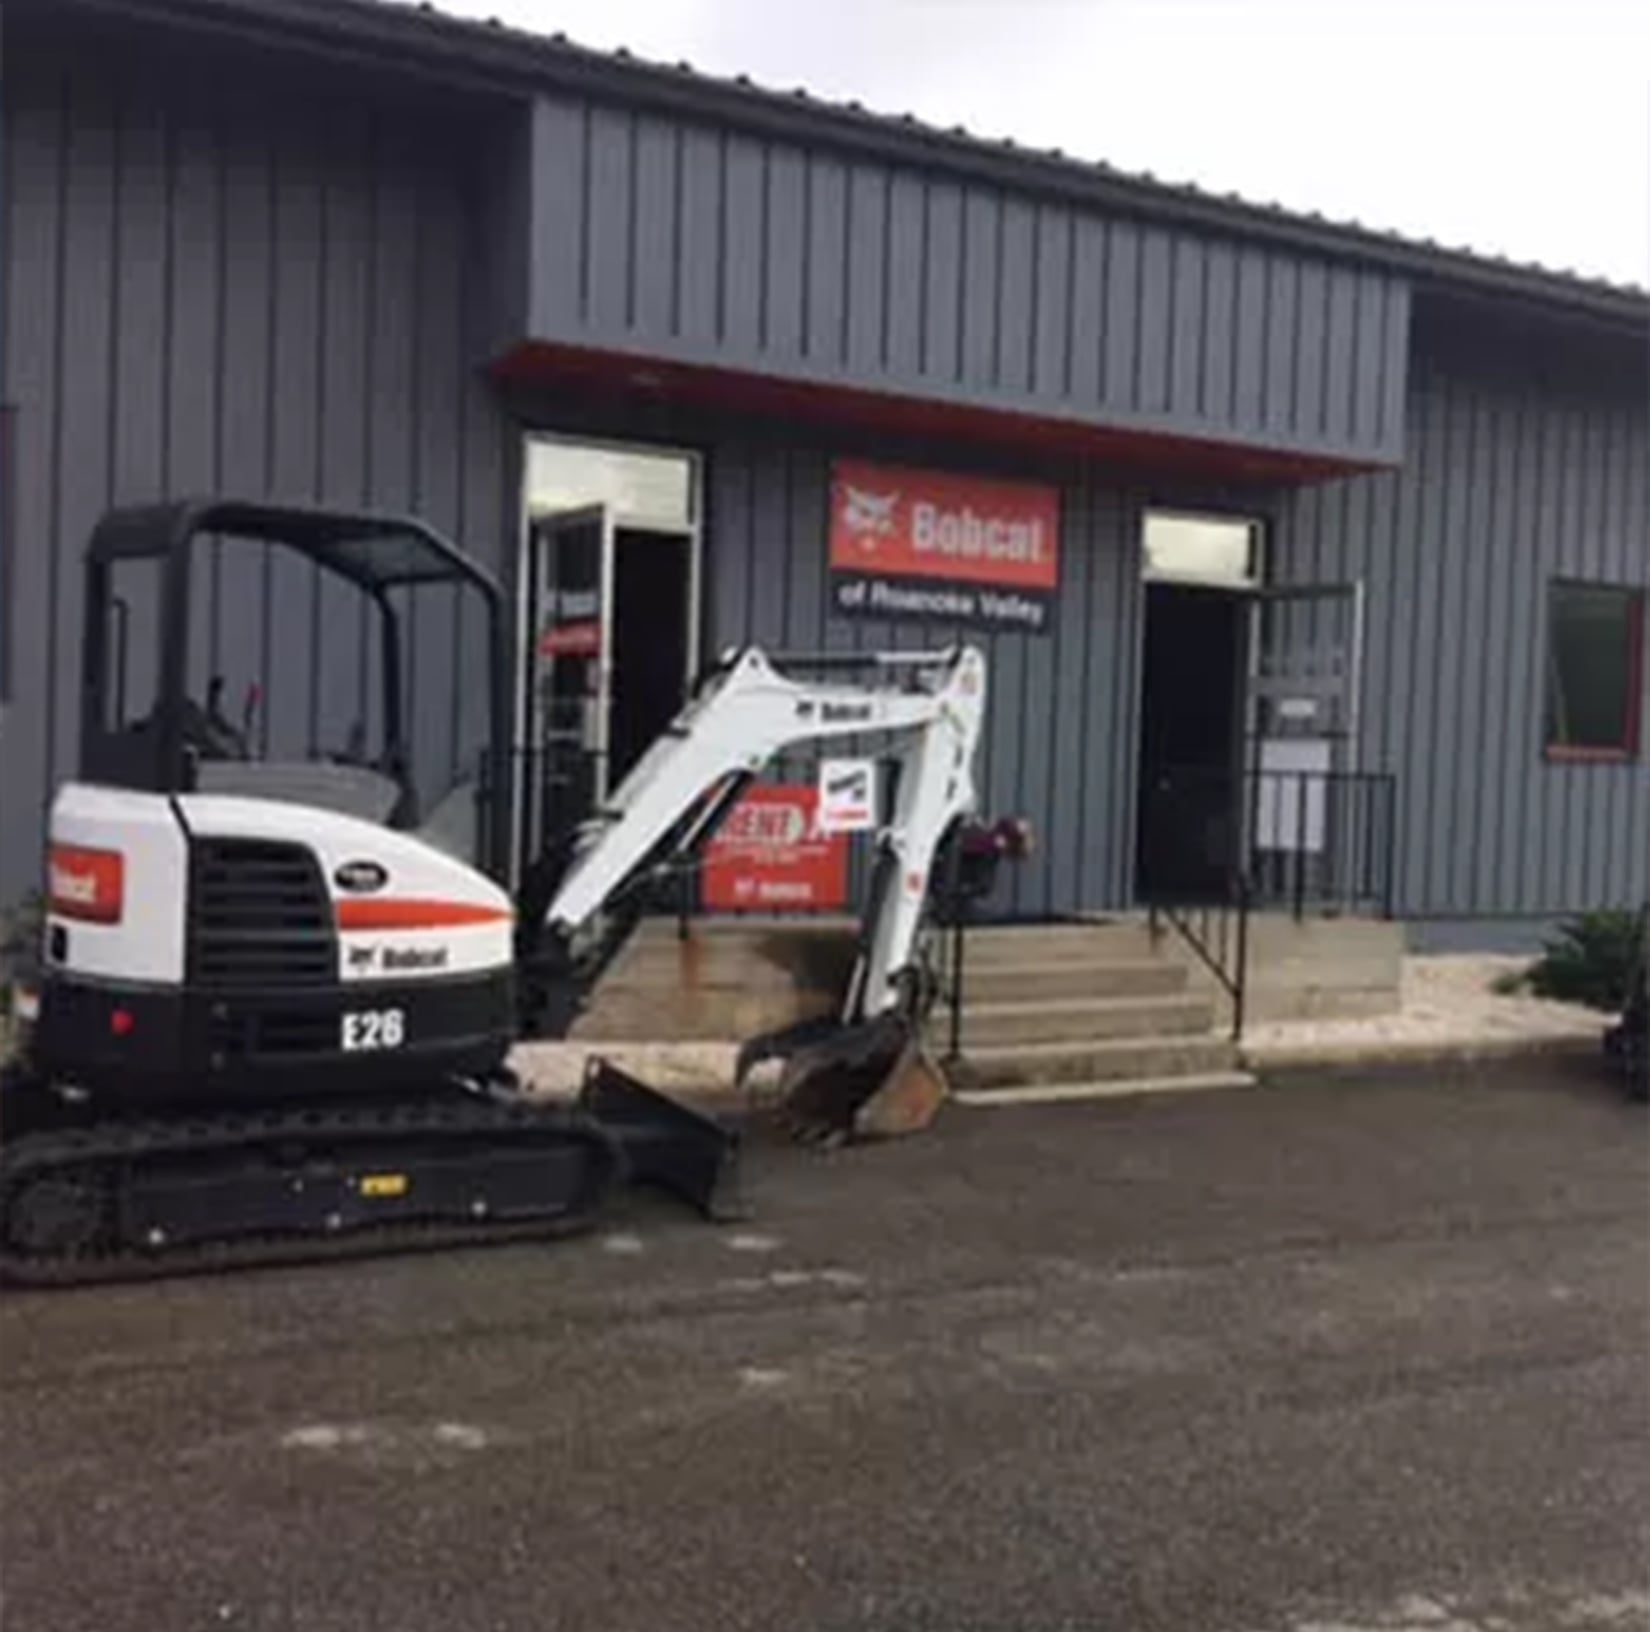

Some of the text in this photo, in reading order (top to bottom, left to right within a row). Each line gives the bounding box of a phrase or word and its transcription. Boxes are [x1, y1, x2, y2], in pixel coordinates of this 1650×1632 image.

[911, 501, 1043, 563] Bobcat
[838, 580, 1044, 626] of Roanoke Valley
[820, 702, 872, 722] Bobcat
[382, 946, 449, 969] Bobcat
[342, 1008, 405, 1050] E26
